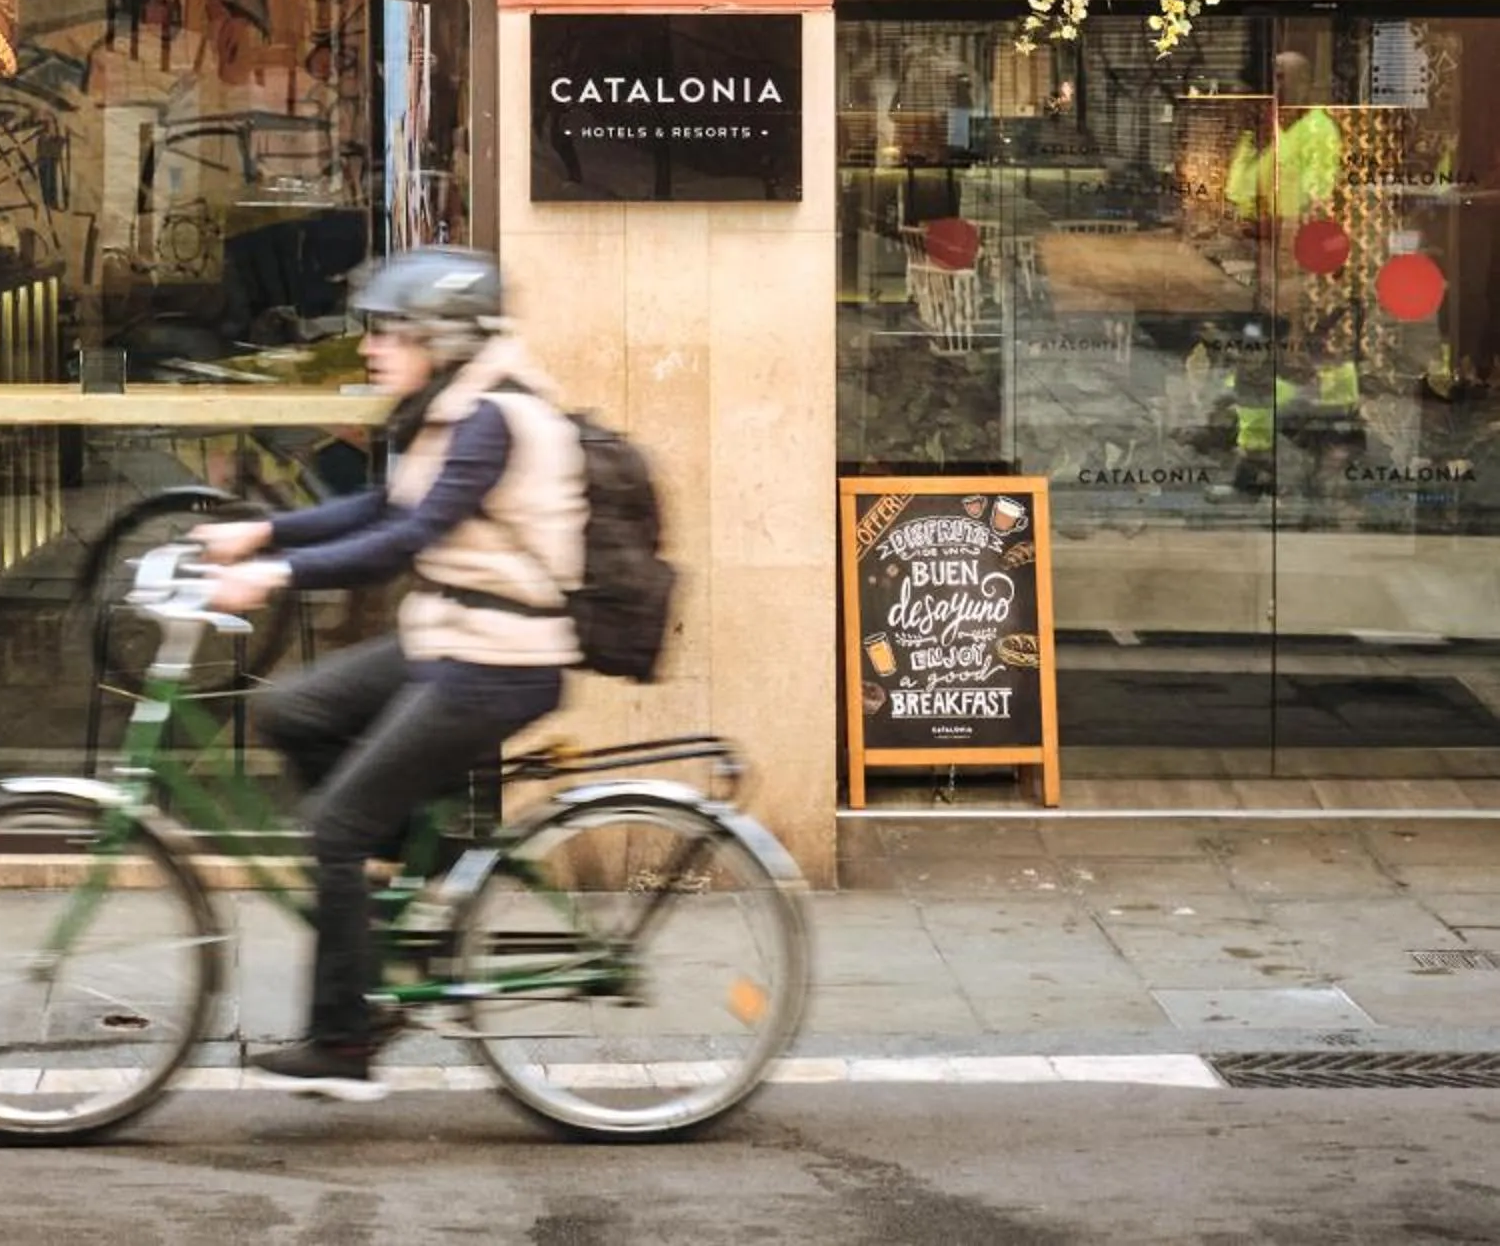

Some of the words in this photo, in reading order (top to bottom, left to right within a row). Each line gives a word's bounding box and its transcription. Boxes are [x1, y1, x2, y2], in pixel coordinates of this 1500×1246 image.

[550, 77, 783, 104] CATALONIA
[581, 127, 647, 139] HOTELS
[655, 127, 664, 139] &
[672, 127, 752, 139] RESORTS
[1348, 171, 1477, 186] CATALONIA
[1078, 468, 1210, 484] CATALONIA
[1345, 465, 1477, 482] CATALONIA
[911, 560, 979, 587] BUEN
[888, 572, 1015, 647] desayuno
[910, 643, 987, 671] ENJOY
[899, 675, 918, 688] a
[925, 654, 1007, 692] good
[890, 690, 1013, 717] BREAKFAST
